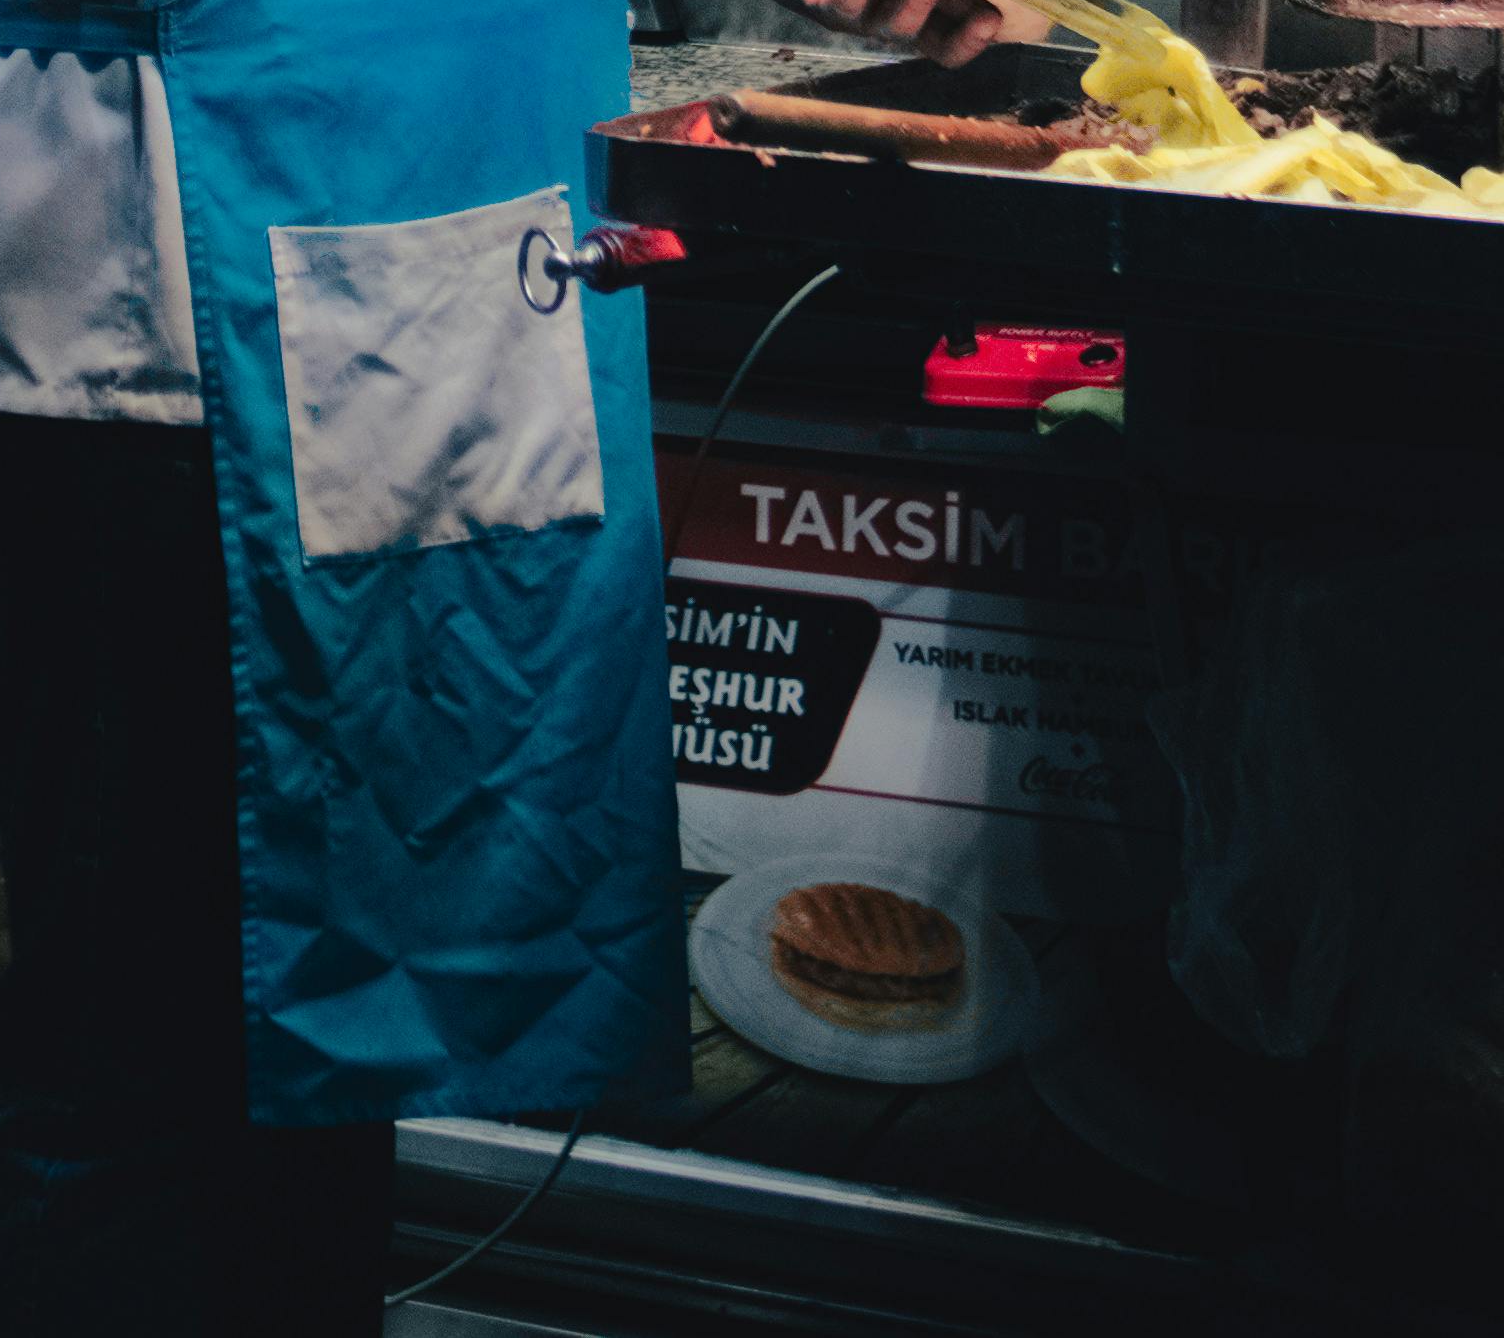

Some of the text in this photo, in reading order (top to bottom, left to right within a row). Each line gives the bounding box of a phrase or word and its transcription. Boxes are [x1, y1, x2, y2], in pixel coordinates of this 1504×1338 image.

[740, 482, 1025, 573] TAKSİM
[665, 596, 800, 656] SİM'İN
[894, 642, 973, 672] YARIM
[668, 664, 806, 717] EŞHUR
[954, 699, 1030, 730] ISLAK
[672, 717, 773, 772] ÜSÜ
